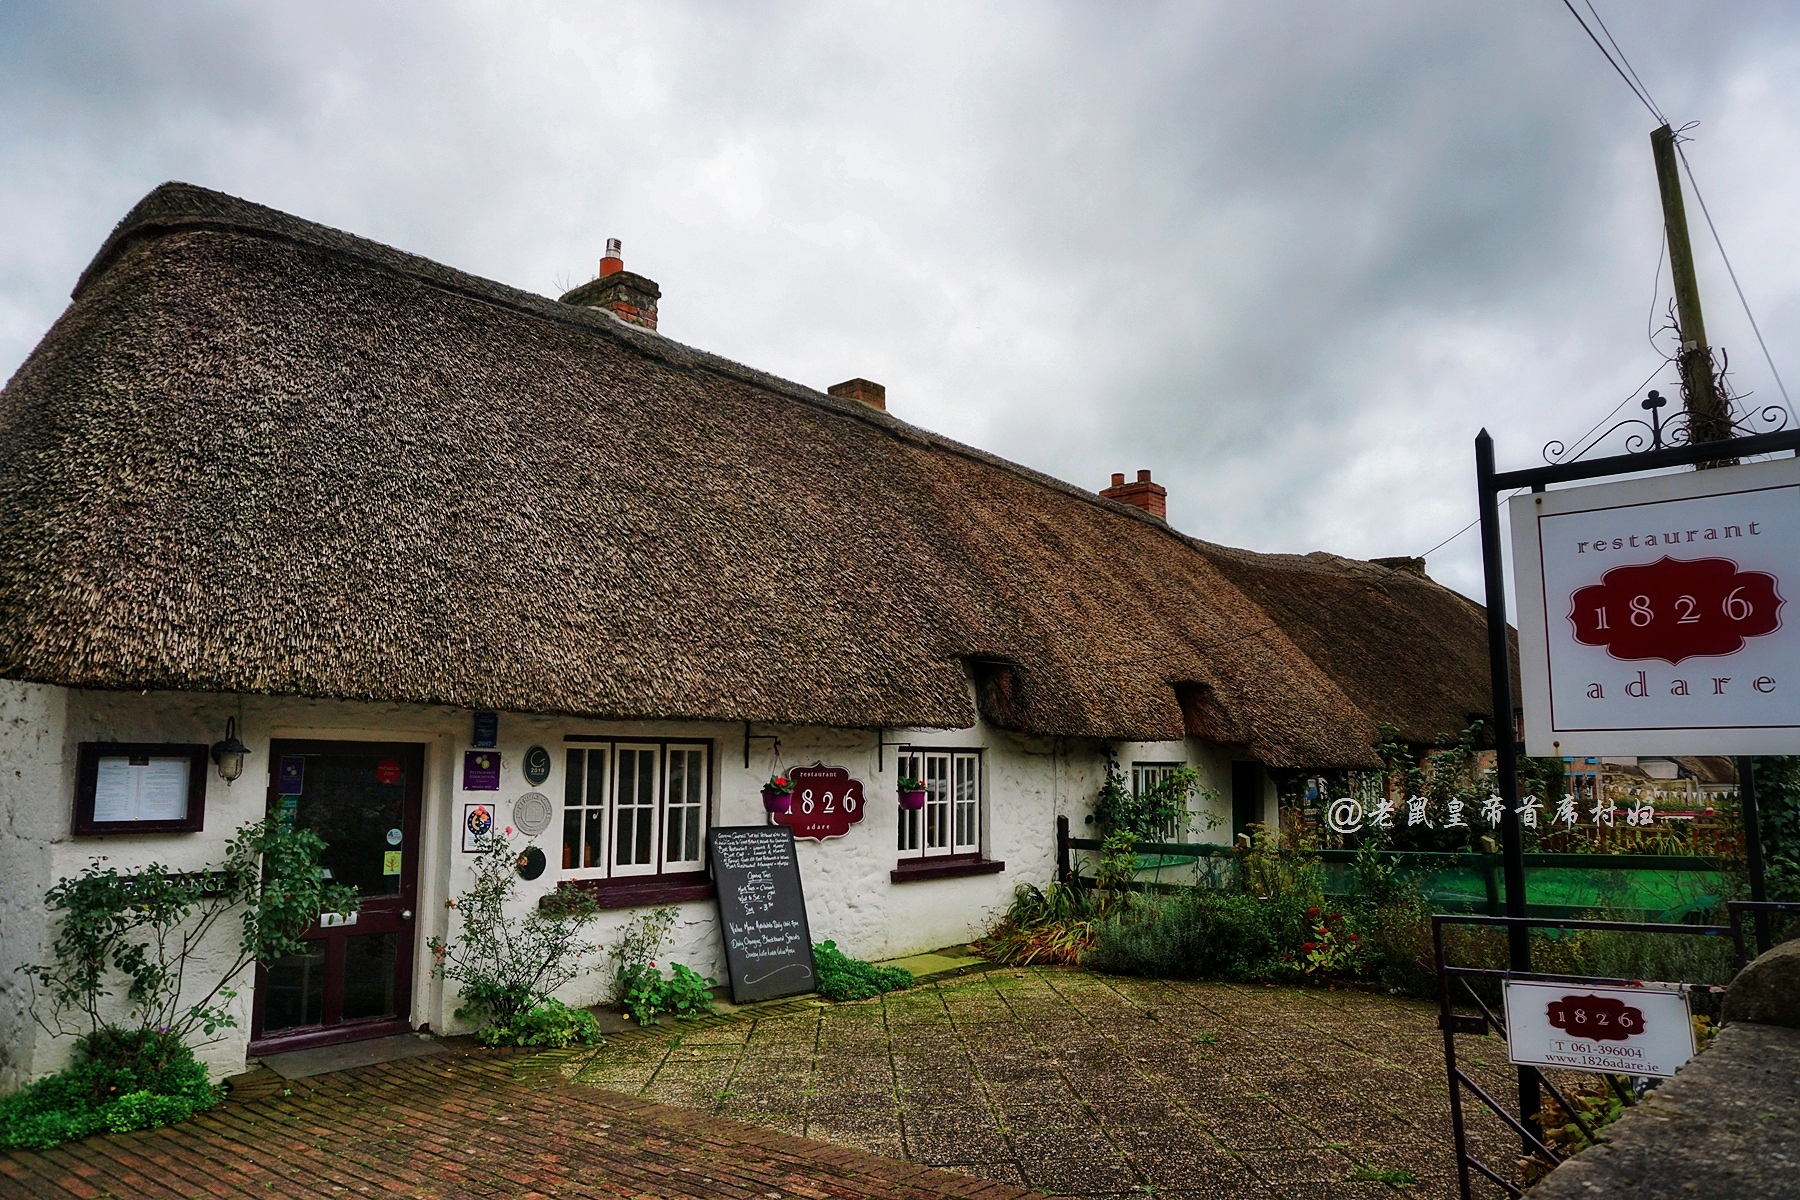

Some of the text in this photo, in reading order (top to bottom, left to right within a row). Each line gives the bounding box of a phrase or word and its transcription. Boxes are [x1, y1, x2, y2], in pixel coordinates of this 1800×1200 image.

[1577, 520, 1762, 554] restaurant
[1594, 586, 1754, 631] 1826
[1586, 670, 1777, 700] adare
[1558, 1008, 1634, 1028] 1826
[1555, 1041, 1643, 1059] T 061-396004
[1545, 1053, 1660, 1073] www.1826adare.ie
